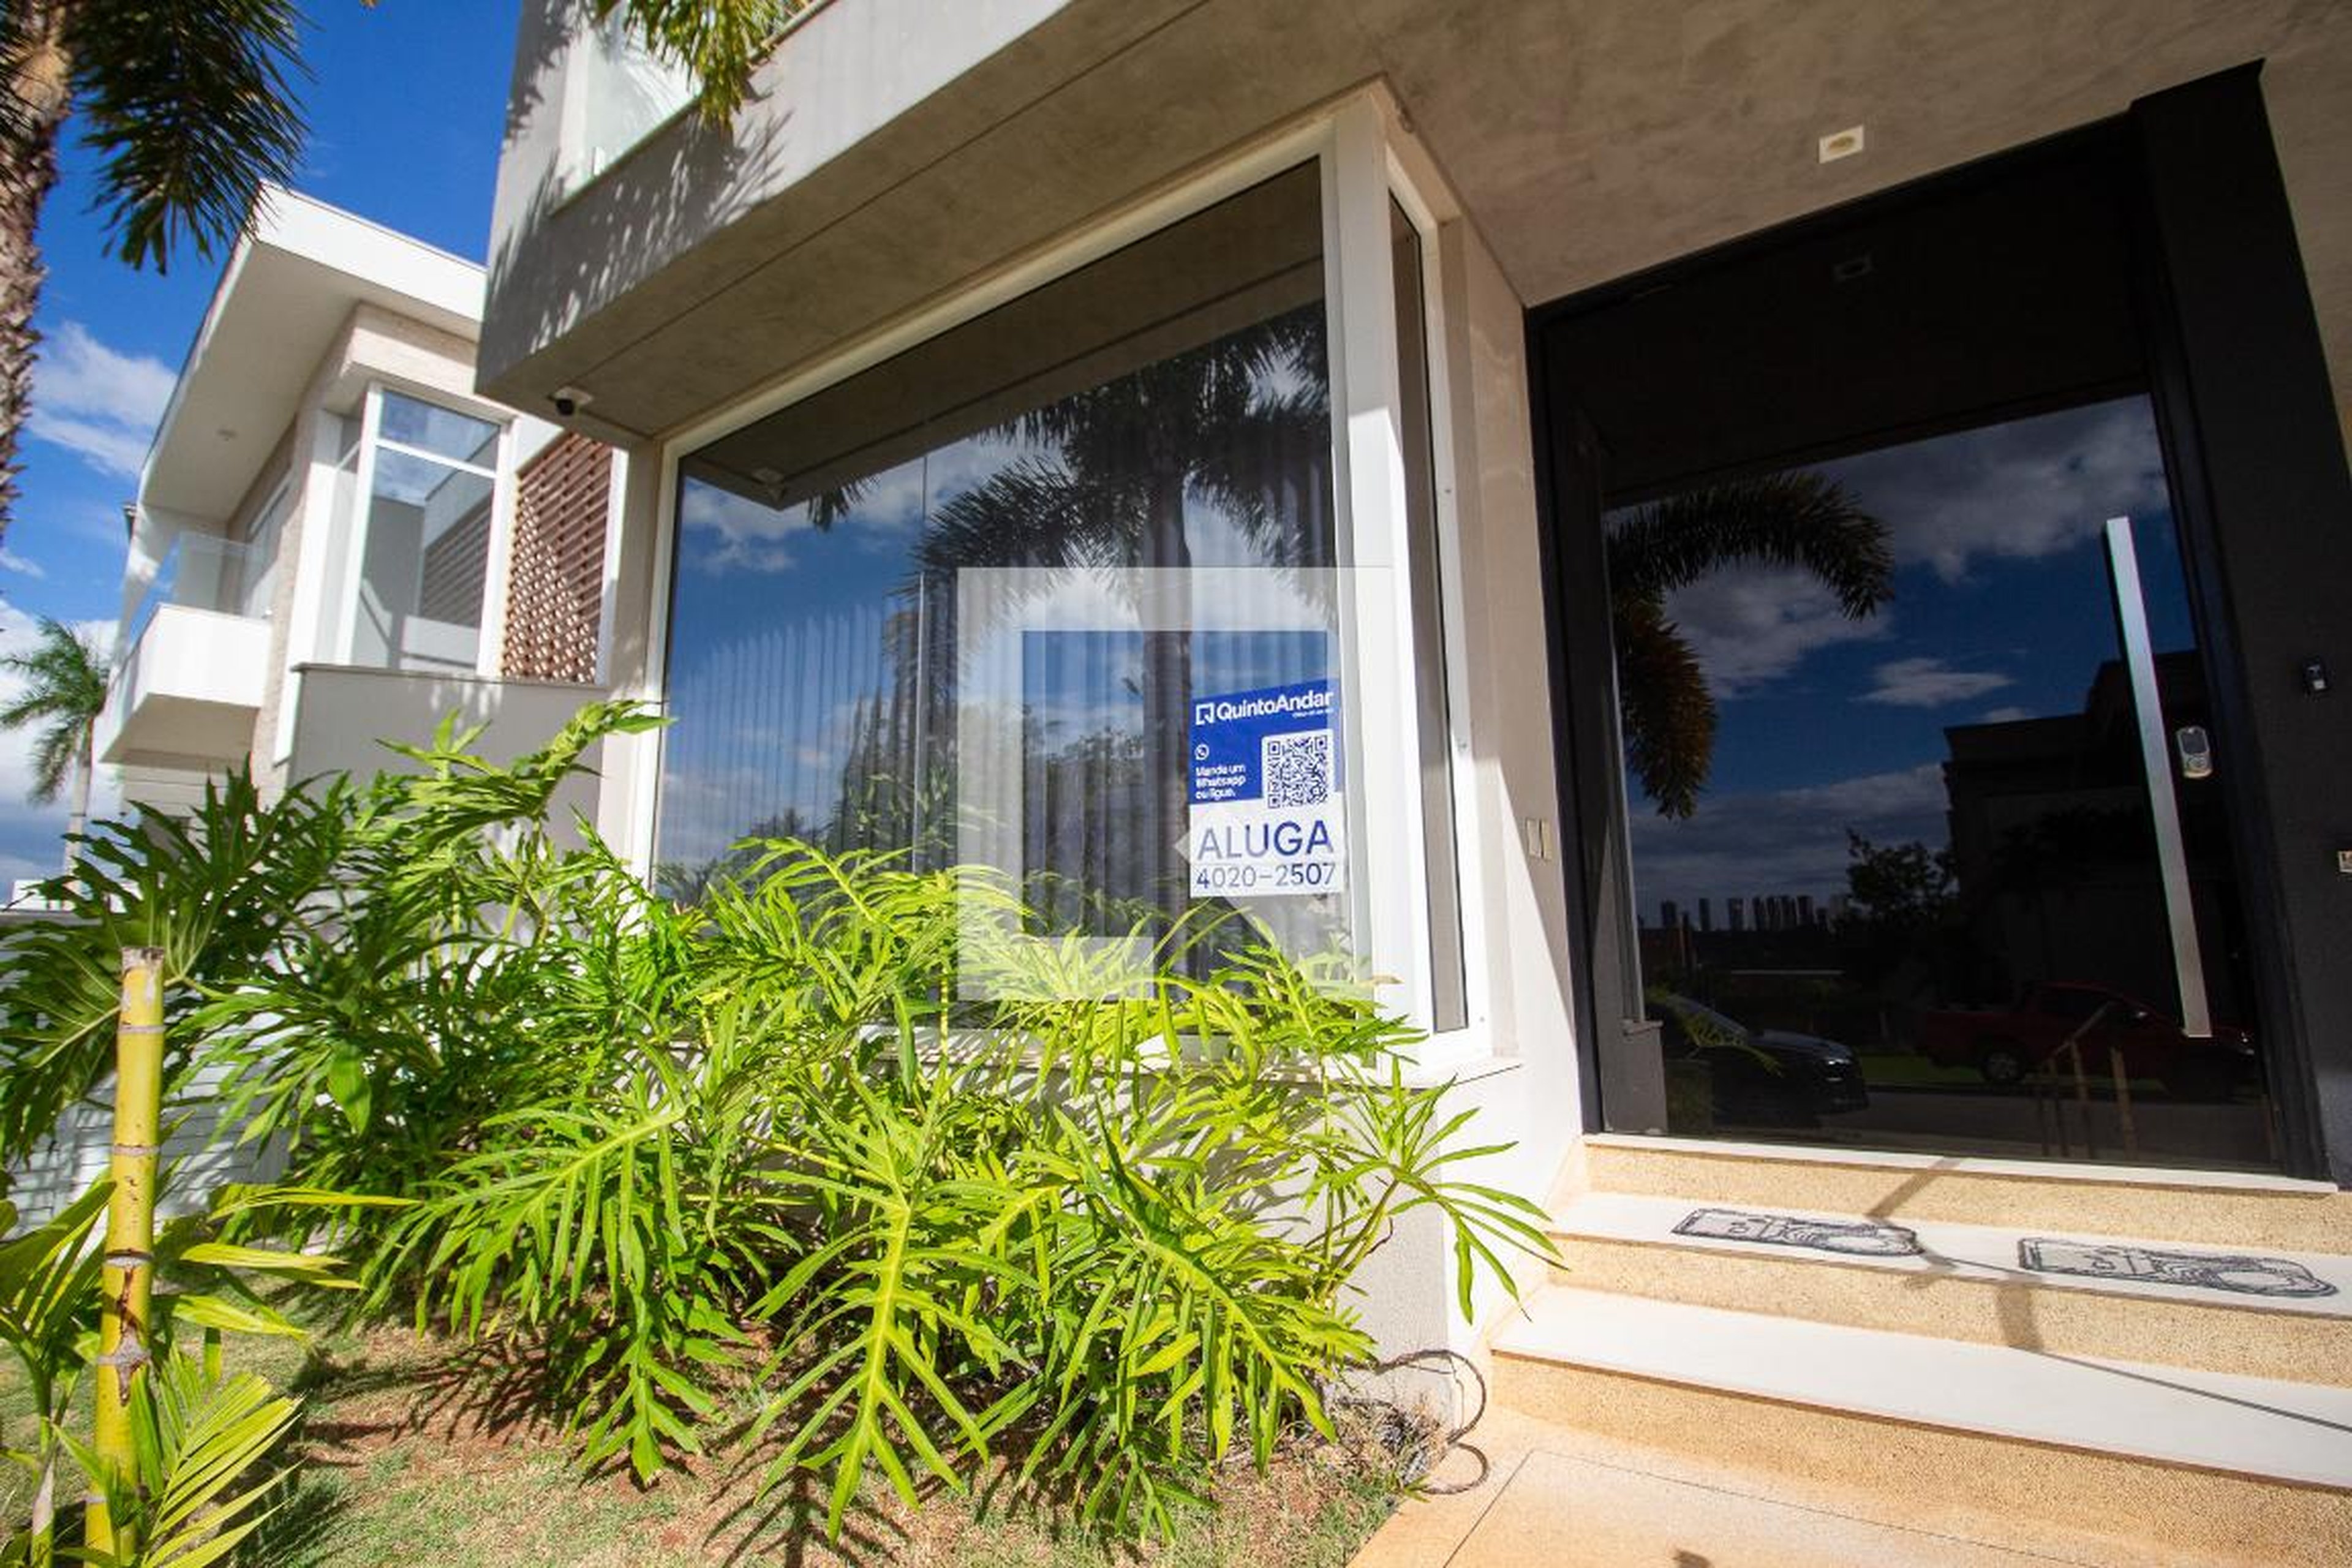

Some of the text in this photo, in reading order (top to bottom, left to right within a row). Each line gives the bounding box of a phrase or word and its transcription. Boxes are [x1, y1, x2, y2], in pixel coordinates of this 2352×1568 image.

[1216, 690, 1334, 721] QuintoAndar
[1229, 764, 1246, 773] um
[1197, 820, 1334, 859] ALUGA
[1196, 863, 1335, 888] 4020-2507
